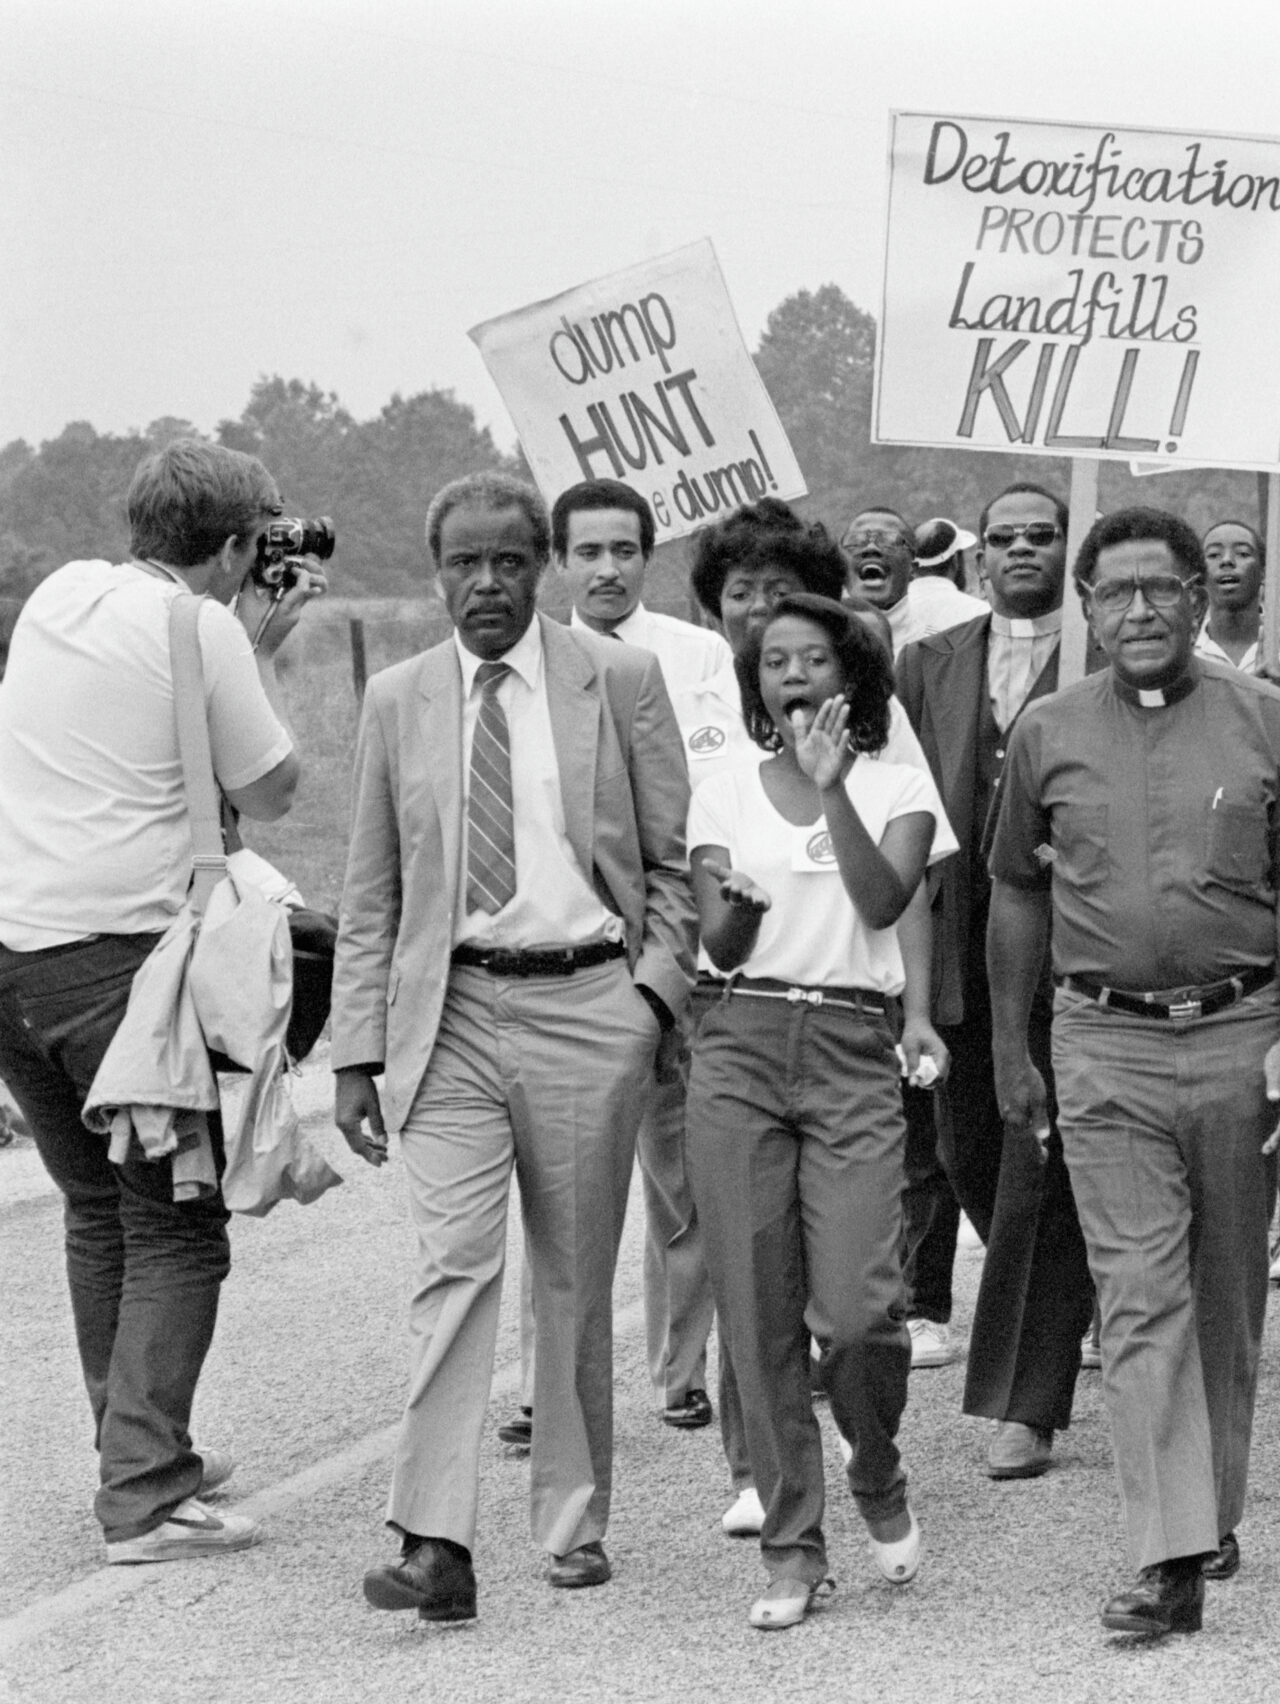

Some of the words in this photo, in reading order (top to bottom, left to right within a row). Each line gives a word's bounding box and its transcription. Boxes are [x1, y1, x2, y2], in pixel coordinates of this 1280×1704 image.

[974, 205, 1205, 265] PROTECTS
[549, 292, 676, 385] dump
[948, 261, 1198, 346] Landfills
[558, 368, 717, 482] HUNT
[956, 336, 1201, 453] KILL!
[673, 429, 779, 522] dump!
